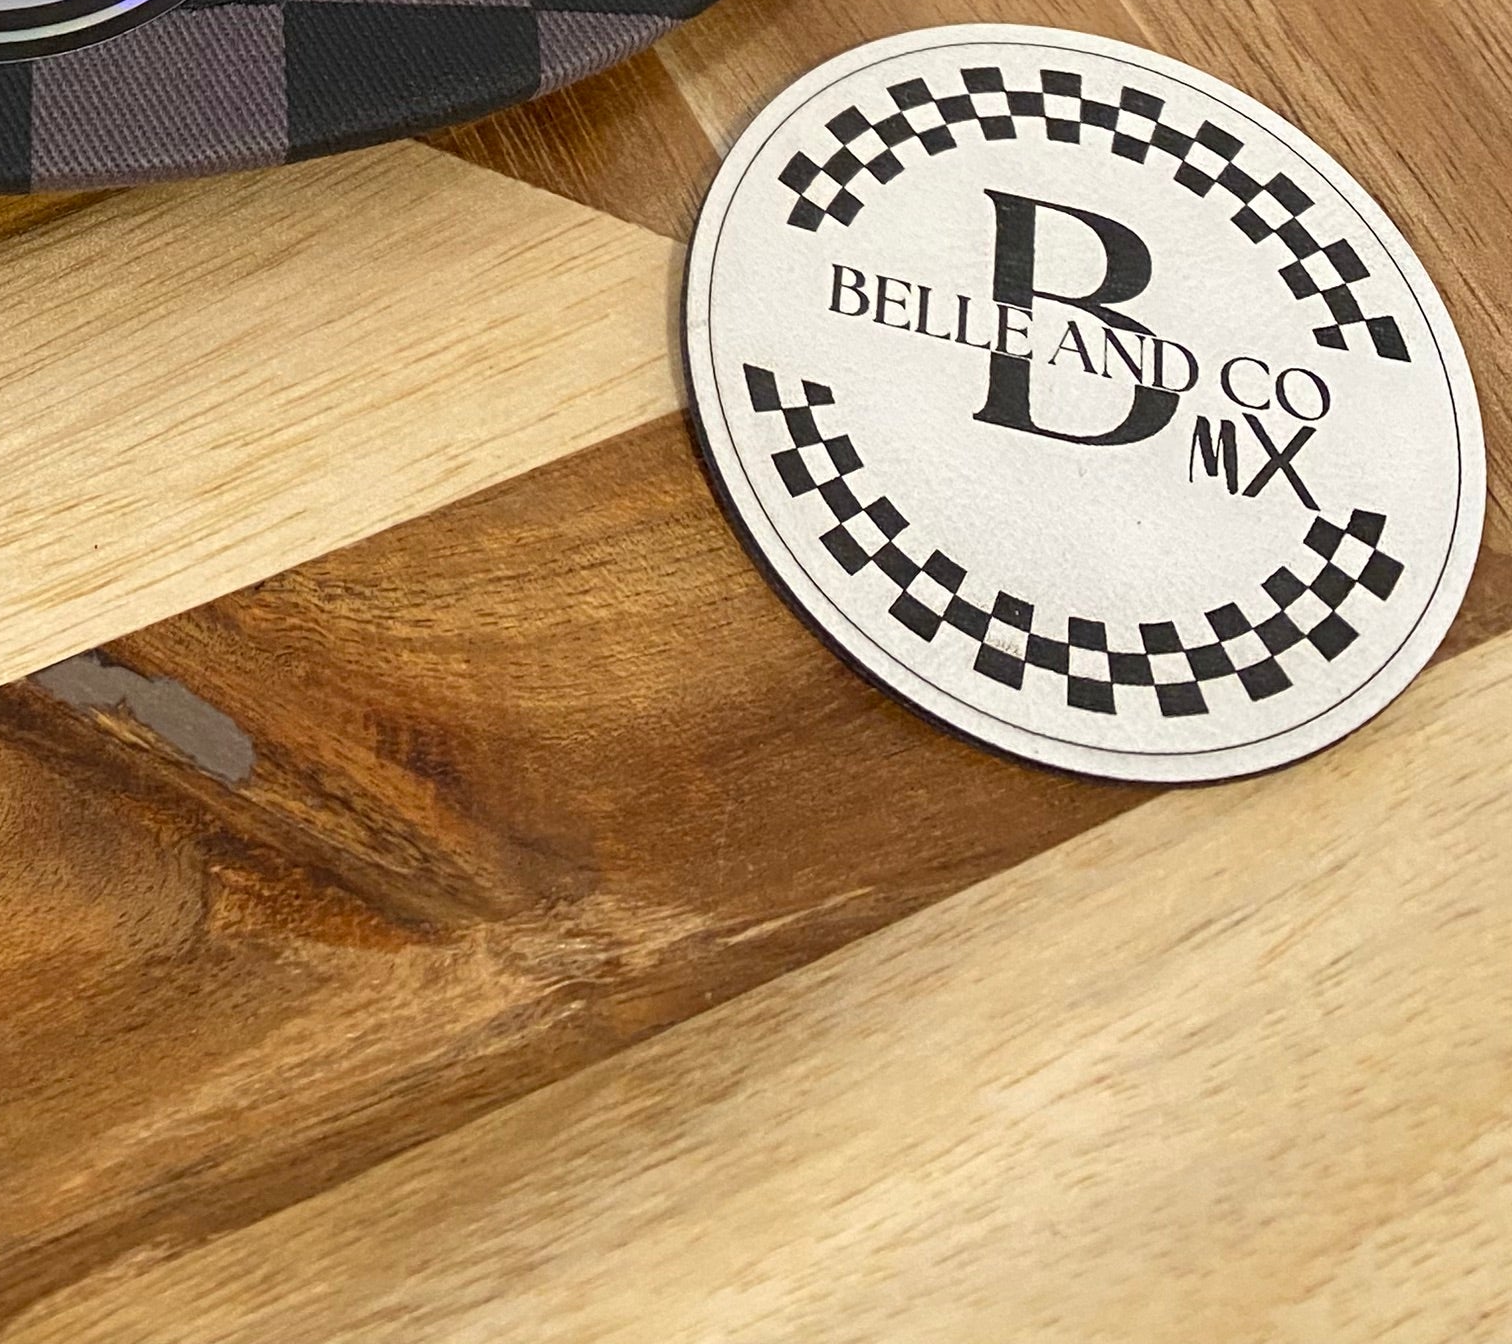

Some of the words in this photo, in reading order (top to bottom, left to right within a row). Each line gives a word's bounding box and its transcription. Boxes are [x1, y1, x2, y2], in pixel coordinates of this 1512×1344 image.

[828, 263, 1034, 361] BELLE
[1048, 319, 1200, 393] AND
[1220, 356, 1331, 421] CO
[1188, 413, 1320, 511] MX
